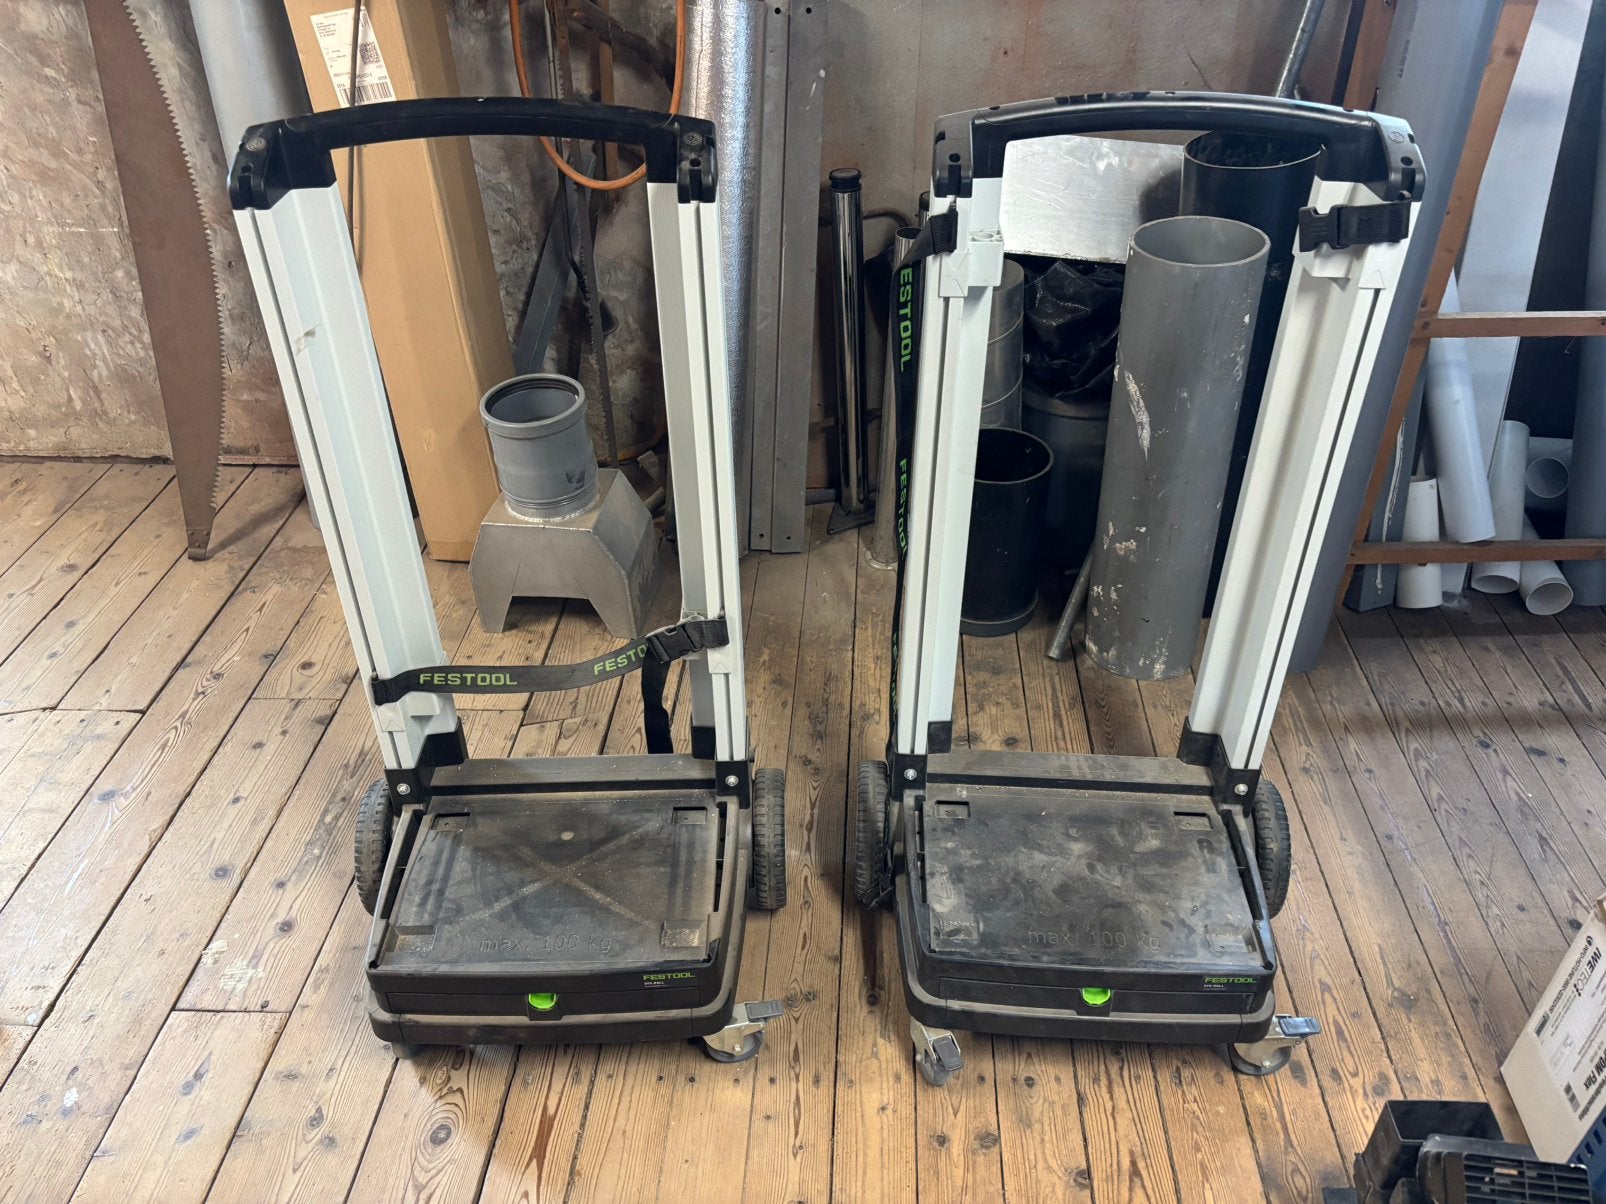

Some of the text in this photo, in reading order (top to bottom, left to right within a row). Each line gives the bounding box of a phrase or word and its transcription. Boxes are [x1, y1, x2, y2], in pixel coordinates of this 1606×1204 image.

[899, 266, 914, 373] ESTOOL
[419, 644, 648, 686] FESTOOL FESTO
[541, 933, 580, 951] 100
[587, 934, 612, 953] kg
[1088, 930, 1128, 948] 100
[1136, 934, 1161, 953] kg
[643, 971, 696, 981] FESTOOL
[1575, 946, 1602, 993] IWETEC
